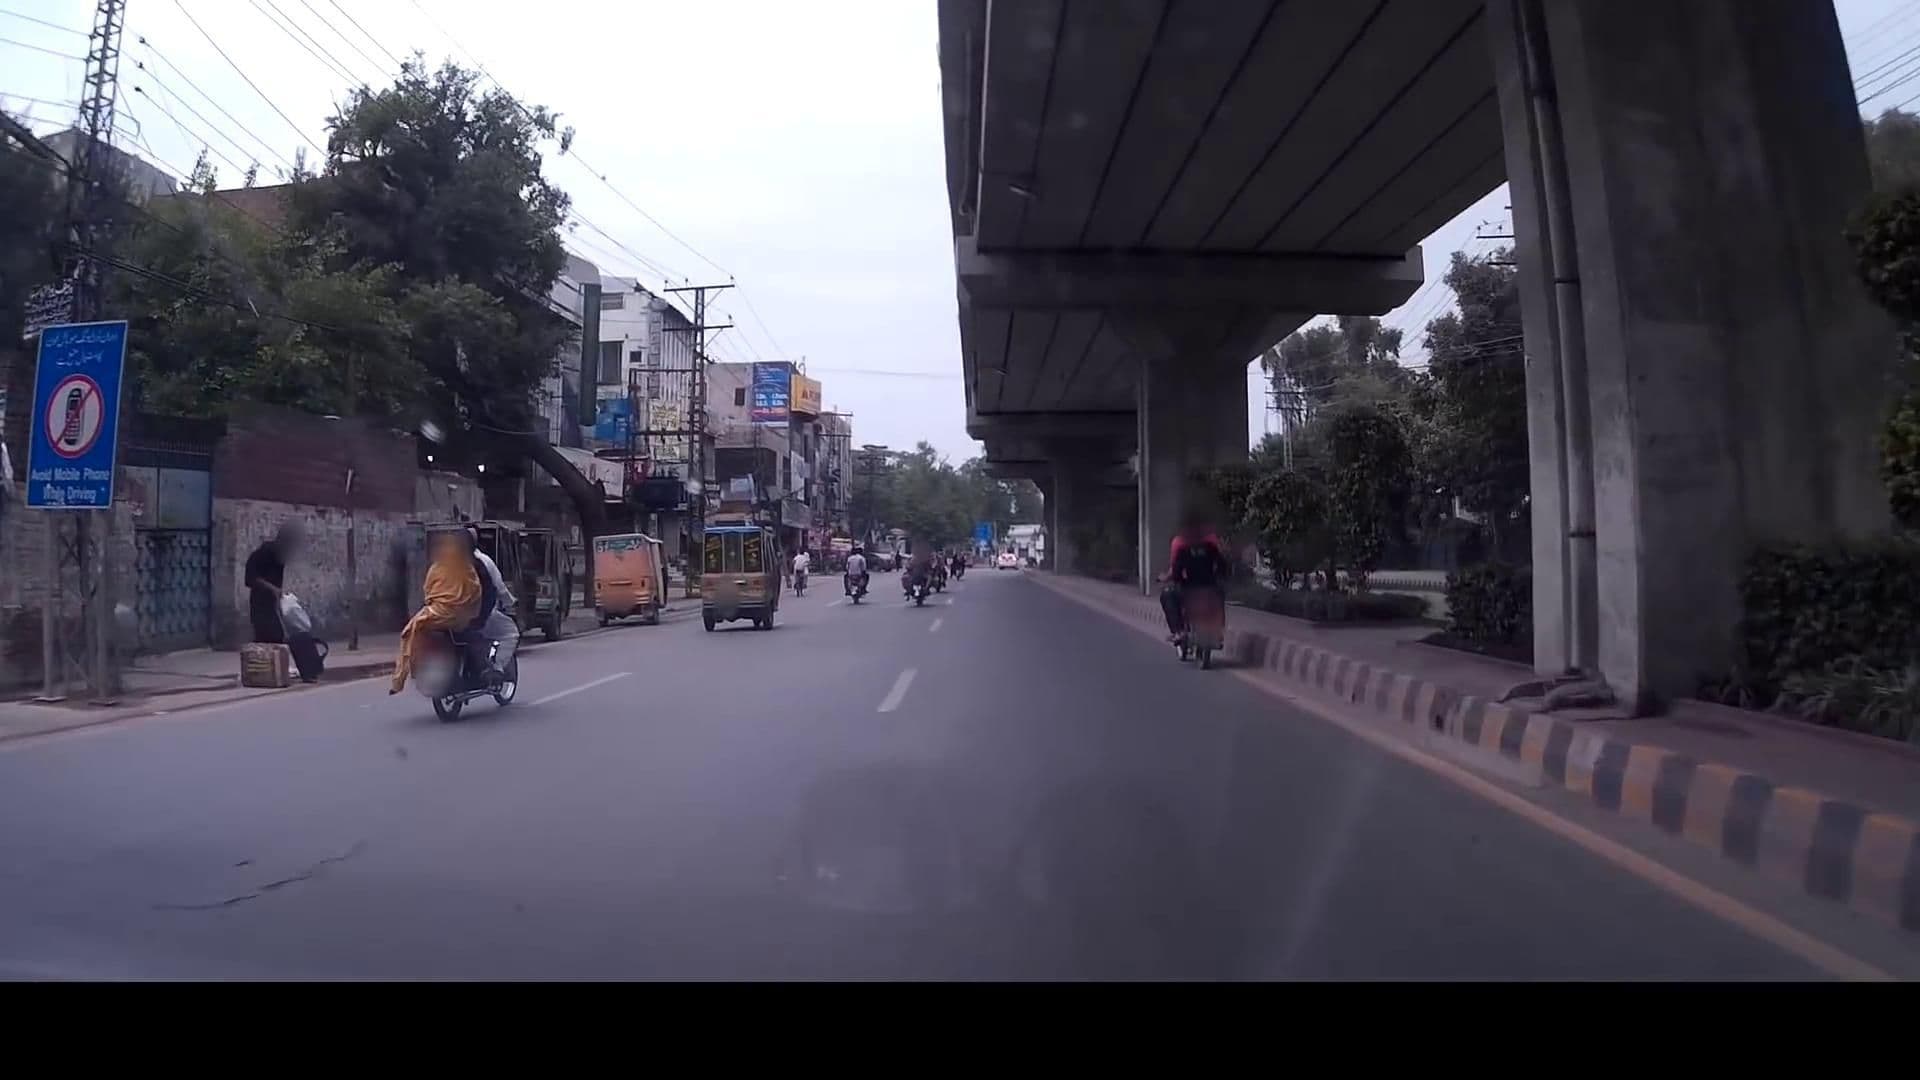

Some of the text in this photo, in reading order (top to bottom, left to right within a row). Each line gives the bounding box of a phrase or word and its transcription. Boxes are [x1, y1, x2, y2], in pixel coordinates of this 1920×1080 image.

[32, 467, 110, 481] Avoid Mobile Phone
[43, 485, 96, 504] While Driving
